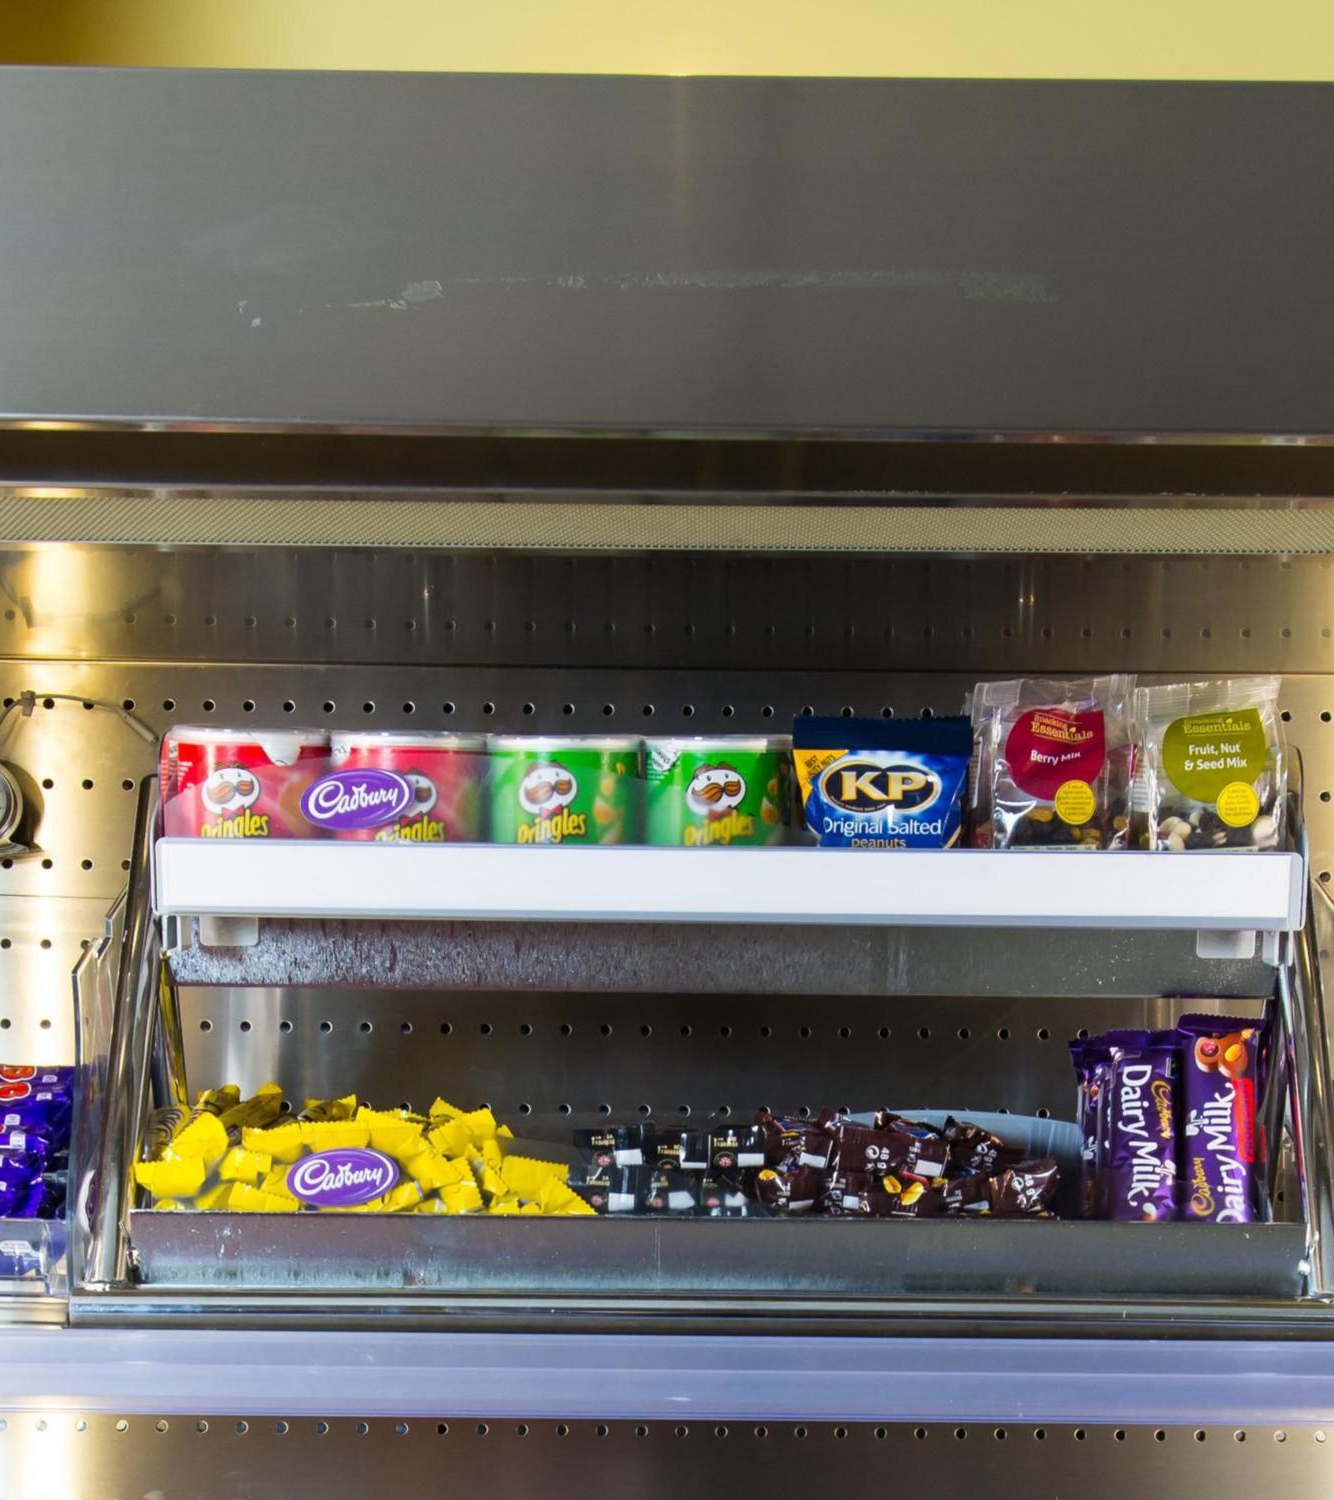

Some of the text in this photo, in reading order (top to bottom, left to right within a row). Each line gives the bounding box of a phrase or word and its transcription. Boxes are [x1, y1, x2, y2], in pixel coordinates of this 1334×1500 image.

[1031, 721, 1094, 741] Essentials
[1030, 749, 1059, 766] Berry
[1184, 756, 1247, 771] & Seed Mix
[1188, 742, 1241, 756] Fruit, Nut
[308, 779, 400, 820] Cadbury
[840, 770, 927, 801] KP
[517, 806, 586, 845] Pringles
[823, 816, 883, 837] Original
[1118, 1064, 1161, 1208] Dairy Milk
[1202, 1082, 1247, 1222] Dairy Milk
[293, 1160, 385, 1197] Cadbury
